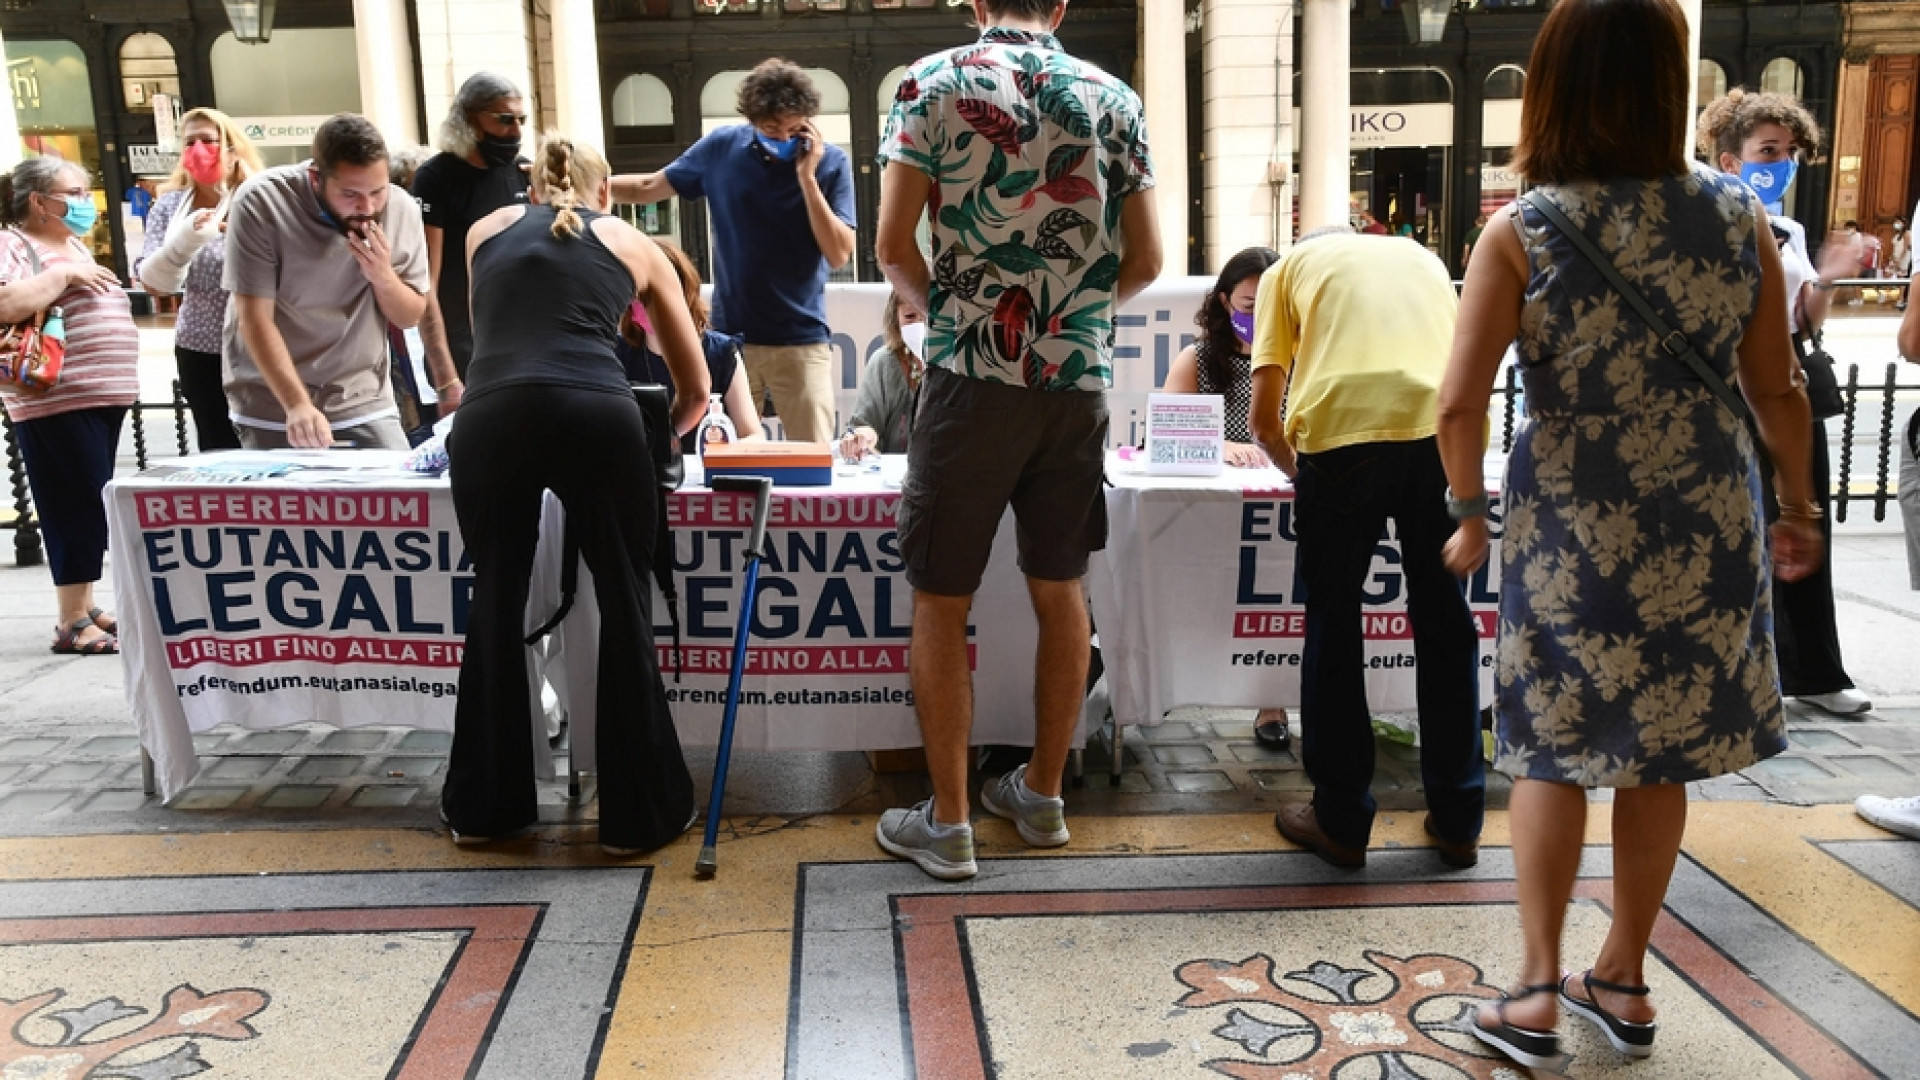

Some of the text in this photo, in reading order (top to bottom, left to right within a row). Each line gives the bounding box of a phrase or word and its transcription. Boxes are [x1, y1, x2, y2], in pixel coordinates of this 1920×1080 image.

[13, 67, 38, 97] hi
[1351, 112, 1406, 133] IKO
[144, 494, 419, 523] REFERENDUM
[666, 495, 900, 523] EFERENDUM
[670, 530, 906, 573] UTANAS
[1242, 615, 1407, 635] LIBE INO
[175, 637, 264, 663] LIBERI
[273, 637, 336, 663] FINO
[347, 640, 418, 662] ALLA
[657, 649, 733, 669] IBERI
[745, 651, 810, 670] FINO
[818, 649, 892, 669] ALLA
[177, 674, 459, 698] referendum.eutanasialega
